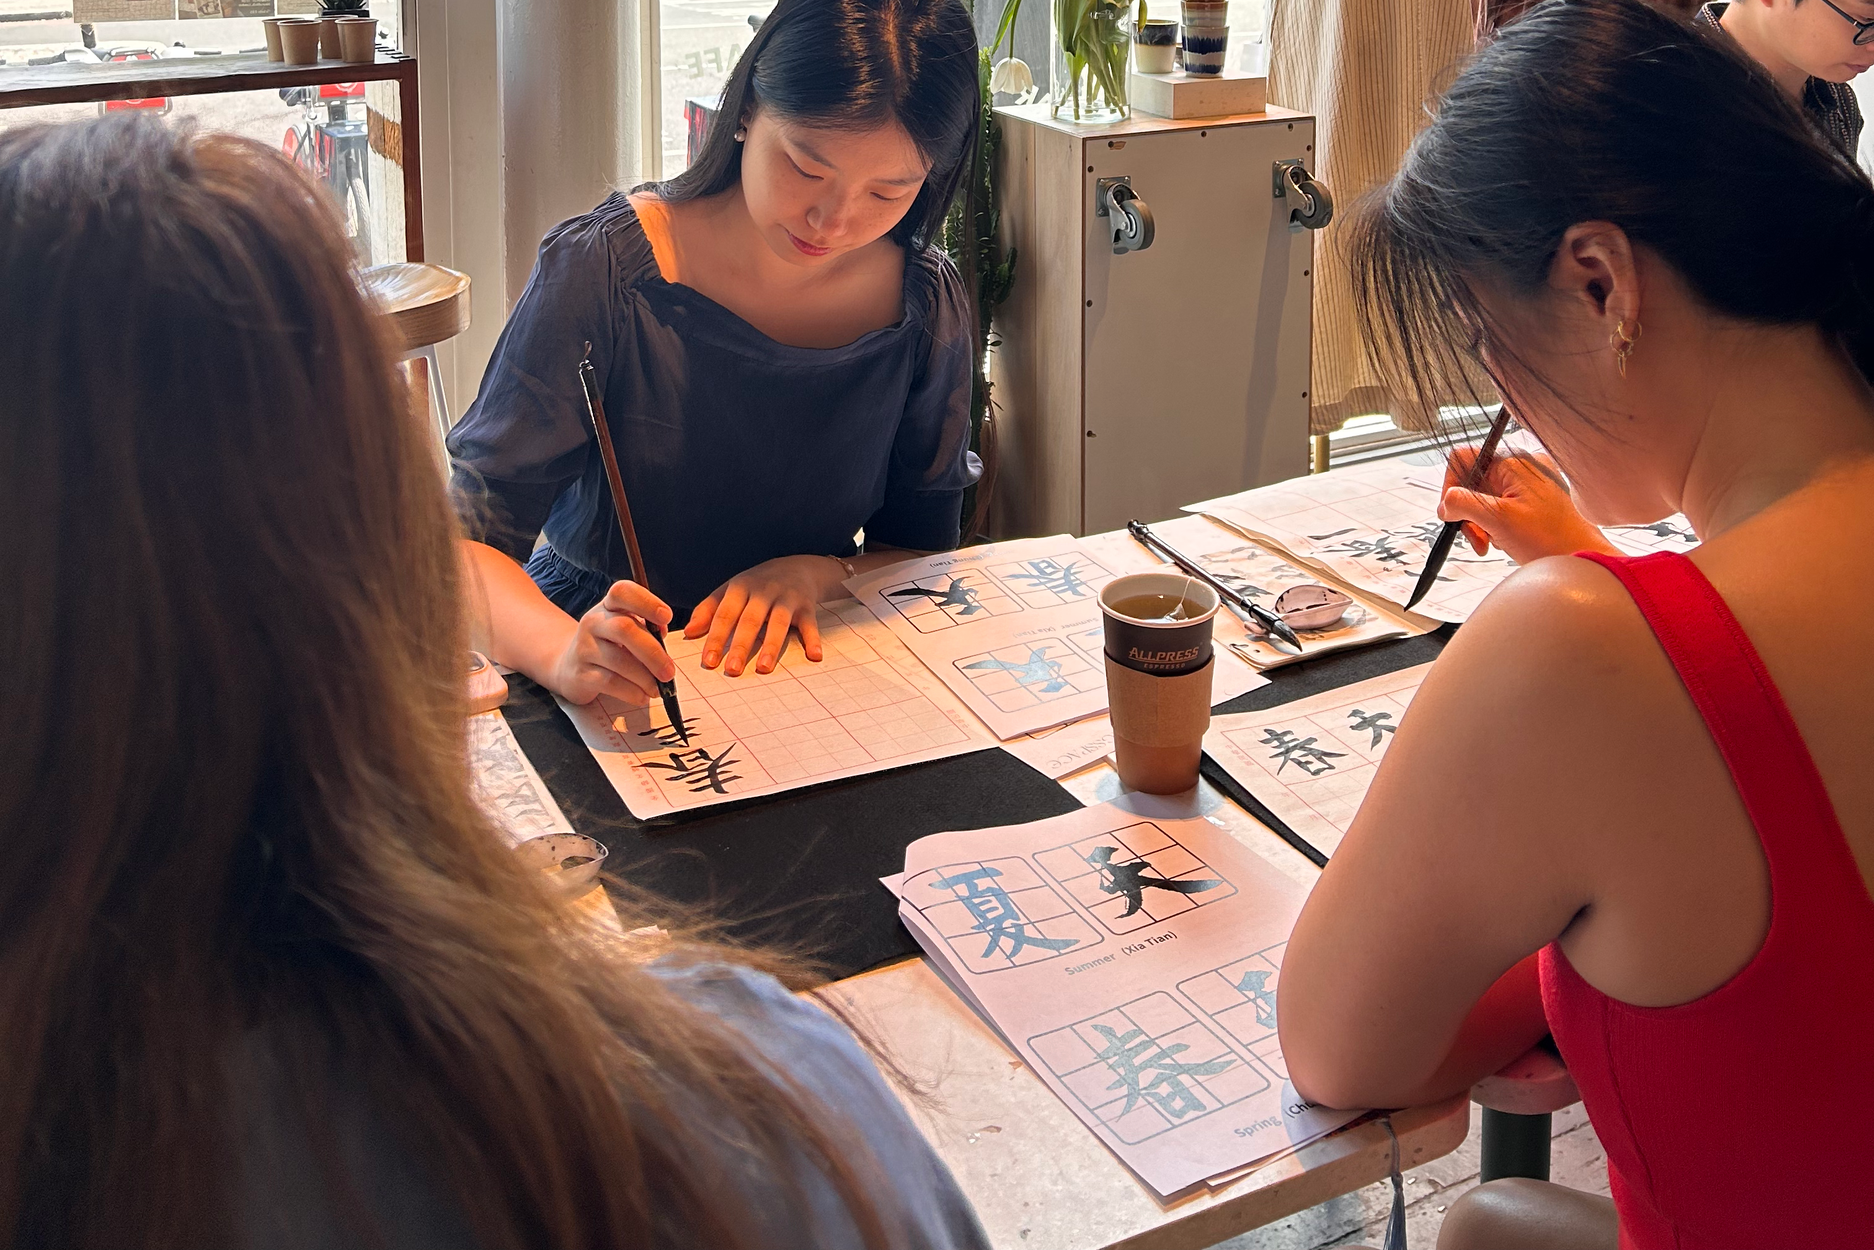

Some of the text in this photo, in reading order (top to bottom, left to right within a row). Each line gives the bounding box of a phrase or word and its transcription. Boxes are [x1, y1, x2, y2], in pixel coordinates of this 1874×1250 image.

[1128, 646, 1200, 662] ALLPRESS
[1143, 662, 1186, 670] ESPRESSO
[1064, 930, 1178, 976] Summer (Xia Tian)
[1234, 1114, 1282, 1139] Spring
